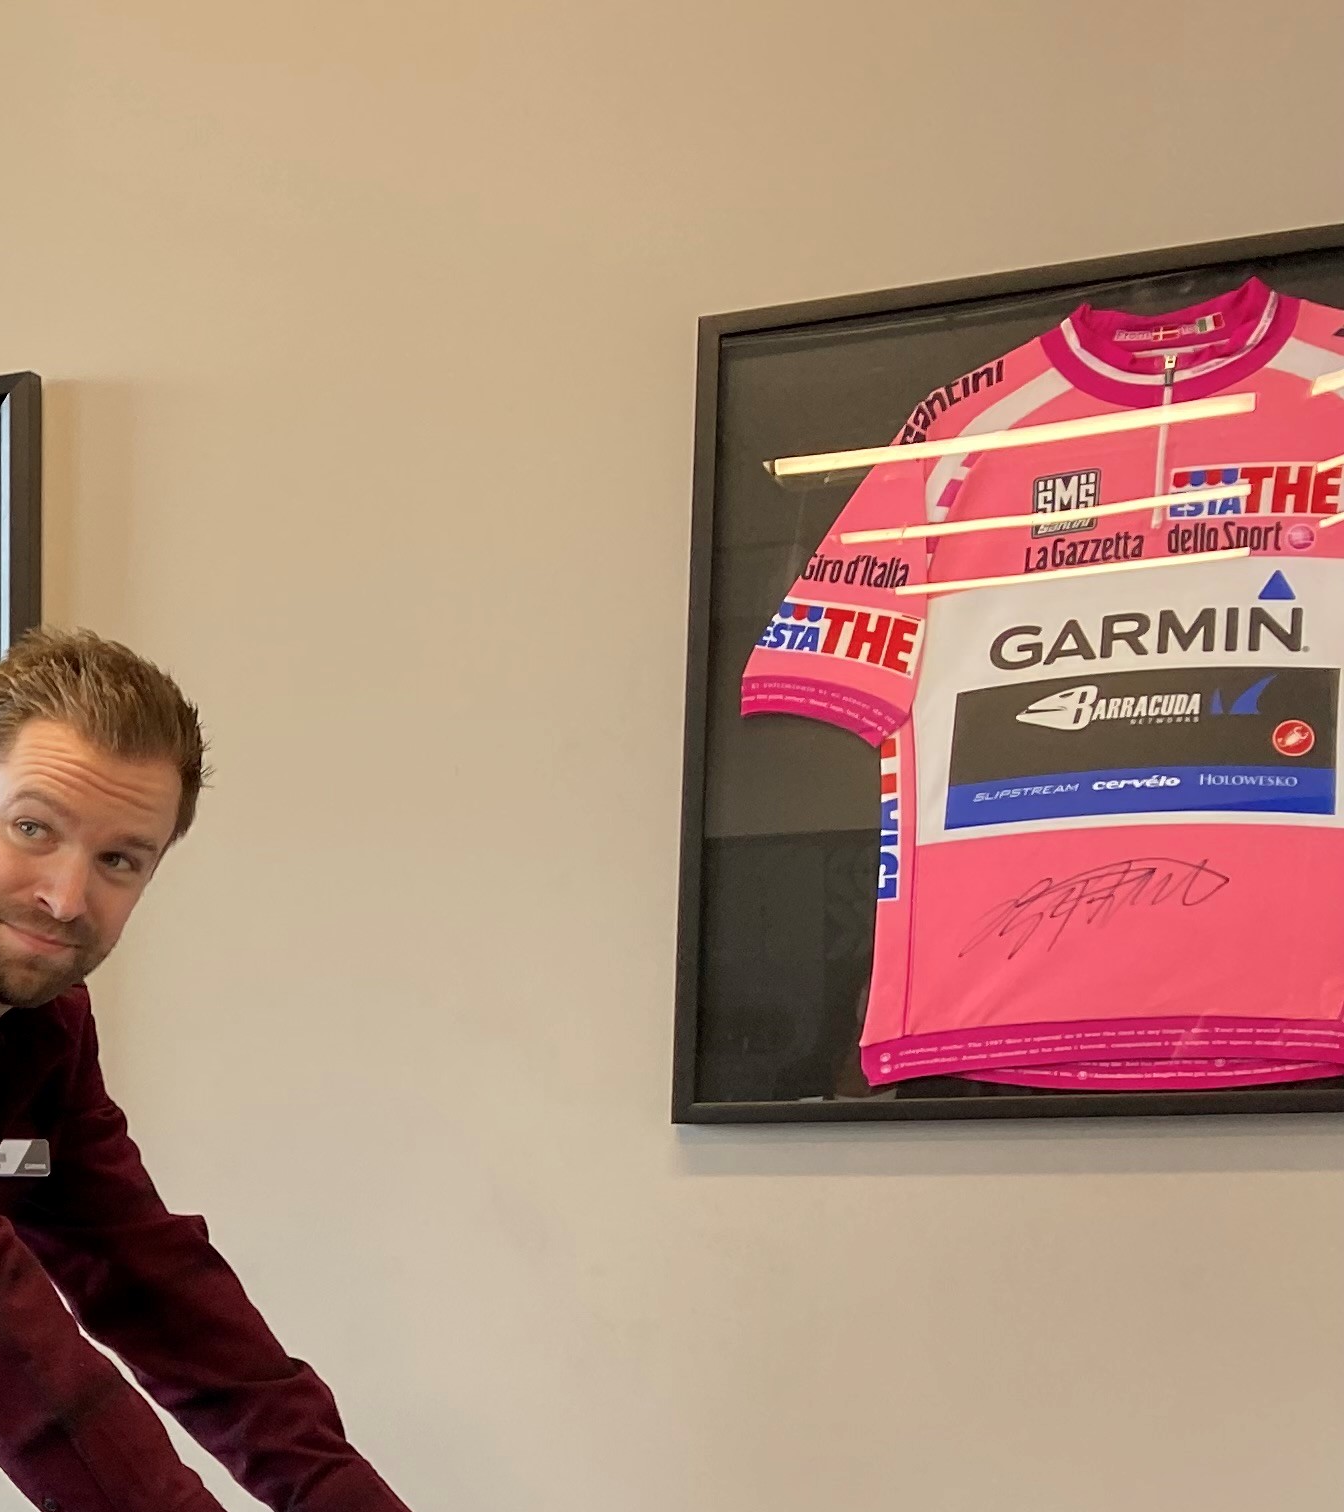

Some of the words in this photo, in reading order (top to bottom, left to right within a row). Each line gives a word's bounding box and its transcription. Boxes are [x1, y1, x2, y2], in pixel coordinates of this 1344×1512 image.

[1024, 546, 1048, 574] La
[1051, 531, 1144, 568] Gazzetta
[1167, 521, 1218, 554] dello
[1221, 521, 1283, 551] Sport
[801, 553, 843, 584] Giro
[989, 607, 1305, 671] GARMIN
[1129, 716, 1200, 726] NETWORKS
[972, 782, 1080, 803] SLIPSTREAM
[1199, 773, 1298, 788] HOLOWESKO
